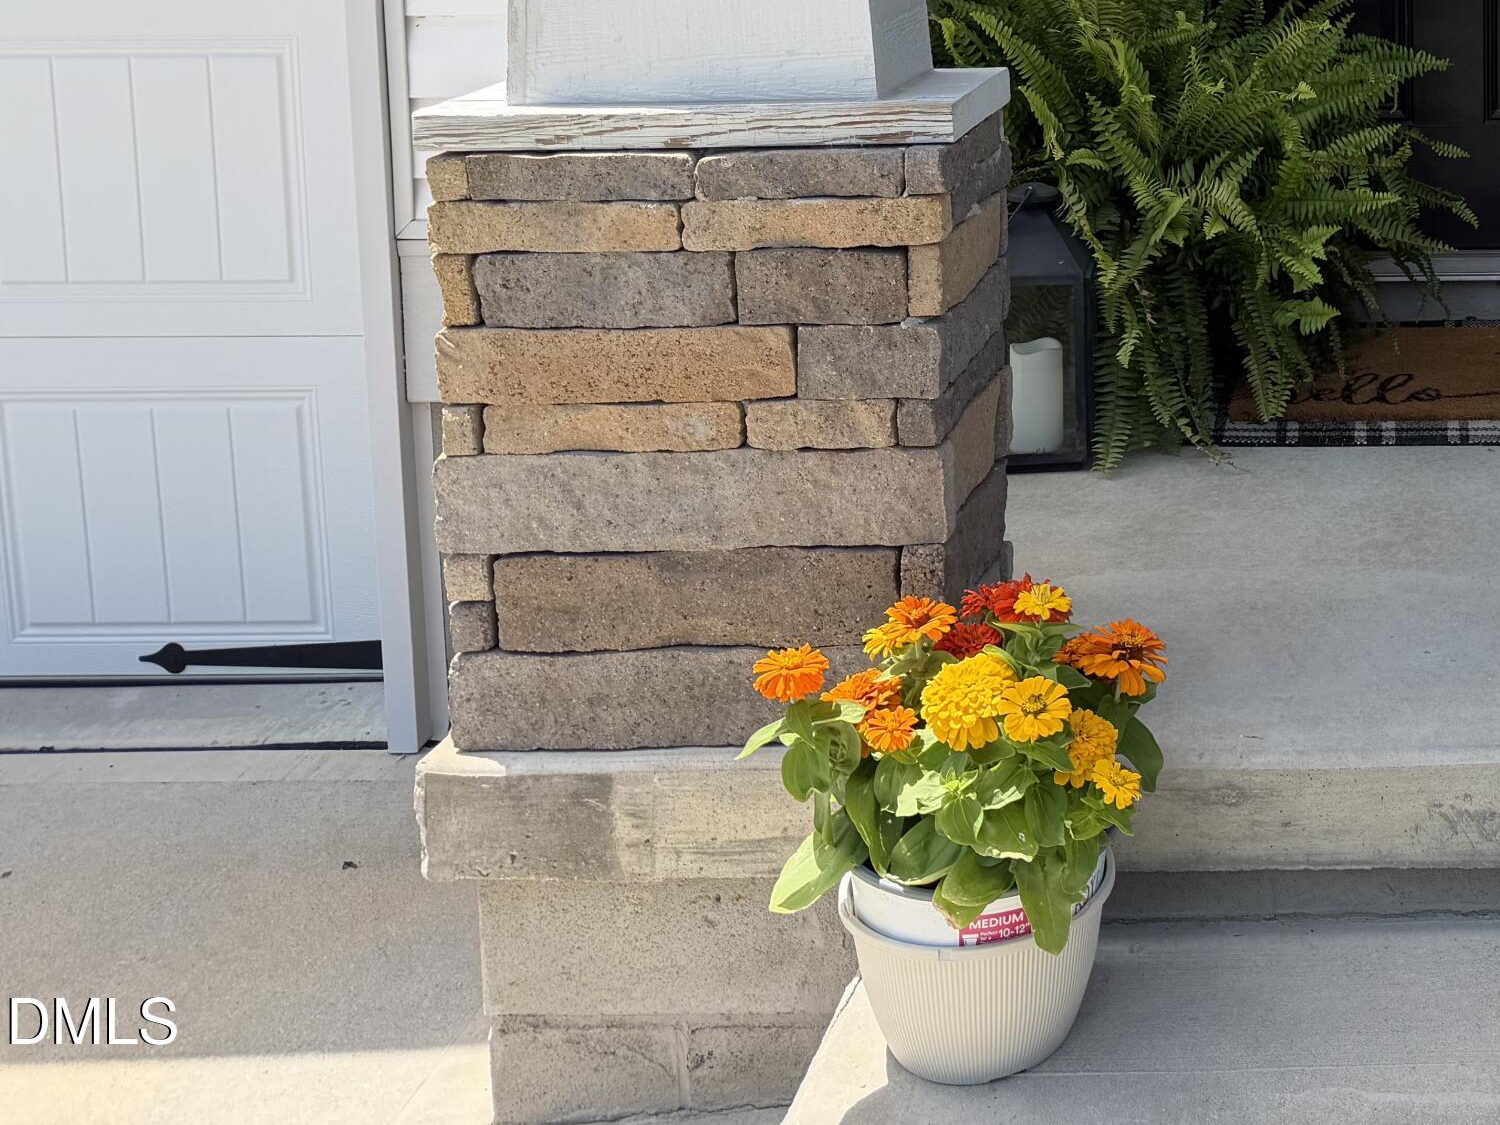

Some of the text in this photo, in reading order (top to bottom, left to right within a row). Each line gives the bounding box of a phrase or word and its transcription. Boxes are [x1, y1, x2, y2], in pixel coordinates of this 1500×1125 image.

[1240, 373, 1442, 406] ello
[969, 911, 1024, 930] MEDIUM
[998, 922, 1031, 938] 10-12"
